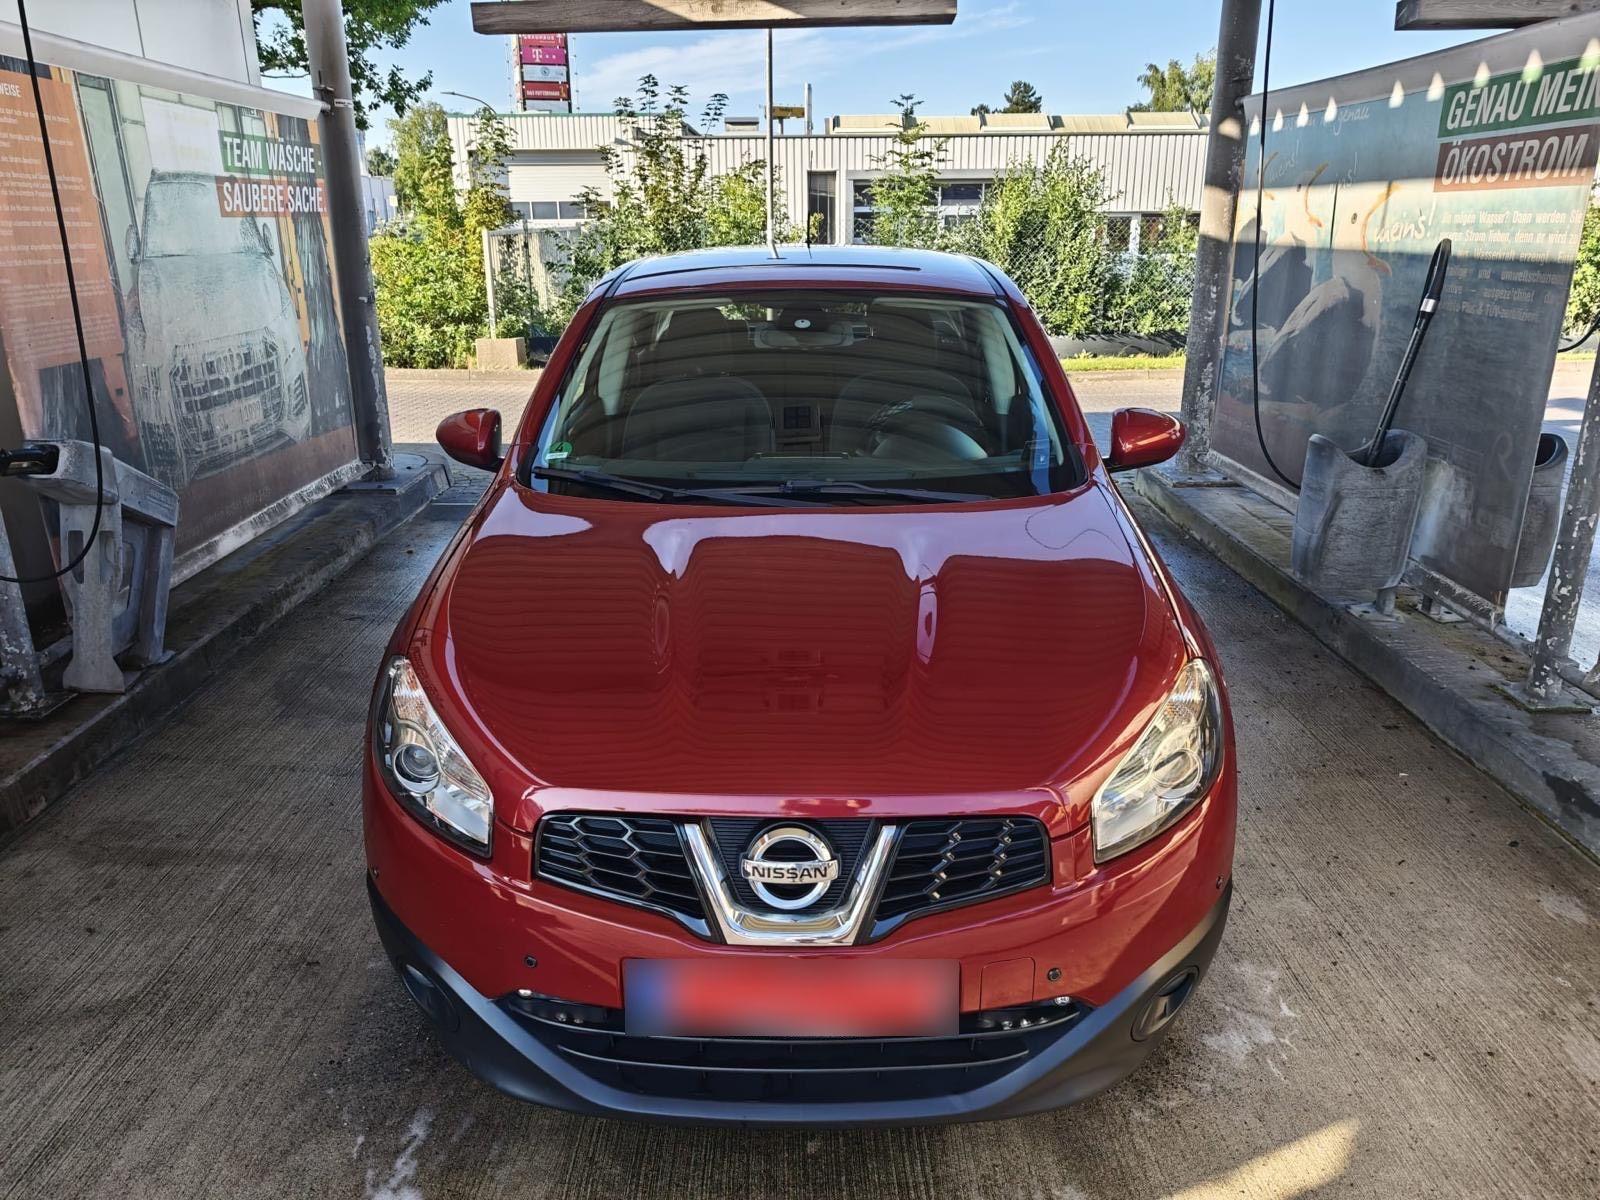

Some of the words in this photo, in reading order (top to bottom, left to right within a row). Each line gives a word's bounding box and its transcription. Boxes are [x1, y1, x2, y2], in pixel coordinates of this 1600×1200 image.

[1446, 80, 1531, 130] GENAU
[1531, 66, 1600, 118] MEIN
[223, 136, 263, 169] TEAM
[265, 137, 315, 174] WÄSCHE
[1441, 133, 1589, 186] ÖKOSTROM.
[223, 181, 285, 213] SAUBERE
[287, 186, 328, 213] SACHE.
[752, 866, 827, 879] NISSAN
